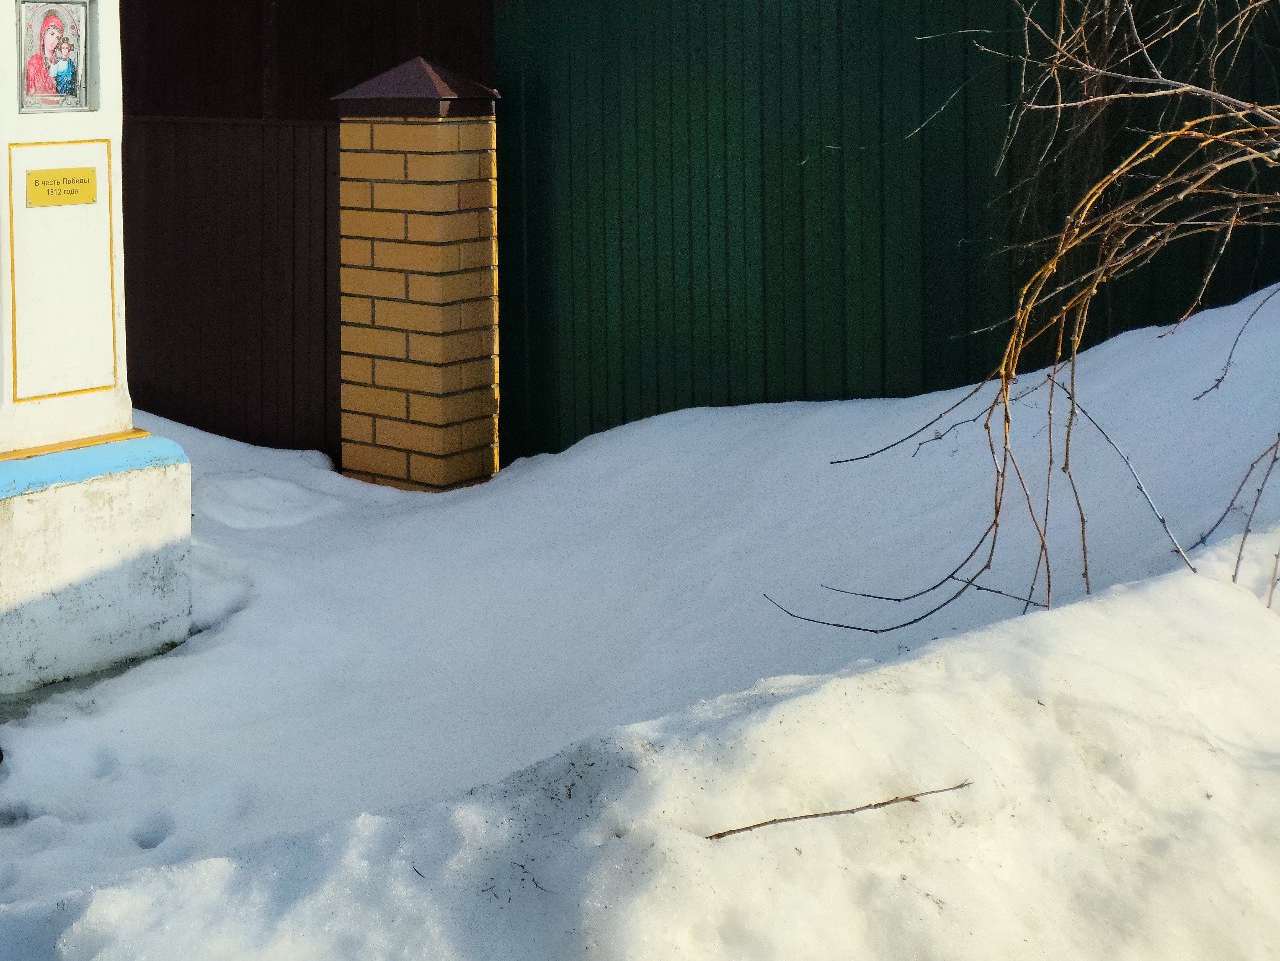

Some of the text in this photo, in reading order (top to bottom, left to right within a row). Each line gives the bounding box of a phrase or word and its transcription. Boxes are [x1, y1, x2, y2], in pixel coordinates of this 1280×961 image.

[34, 179, 40, 187] В
[62, 177, 90, 185] Победы
[46, 188, 62, 196] 1812
